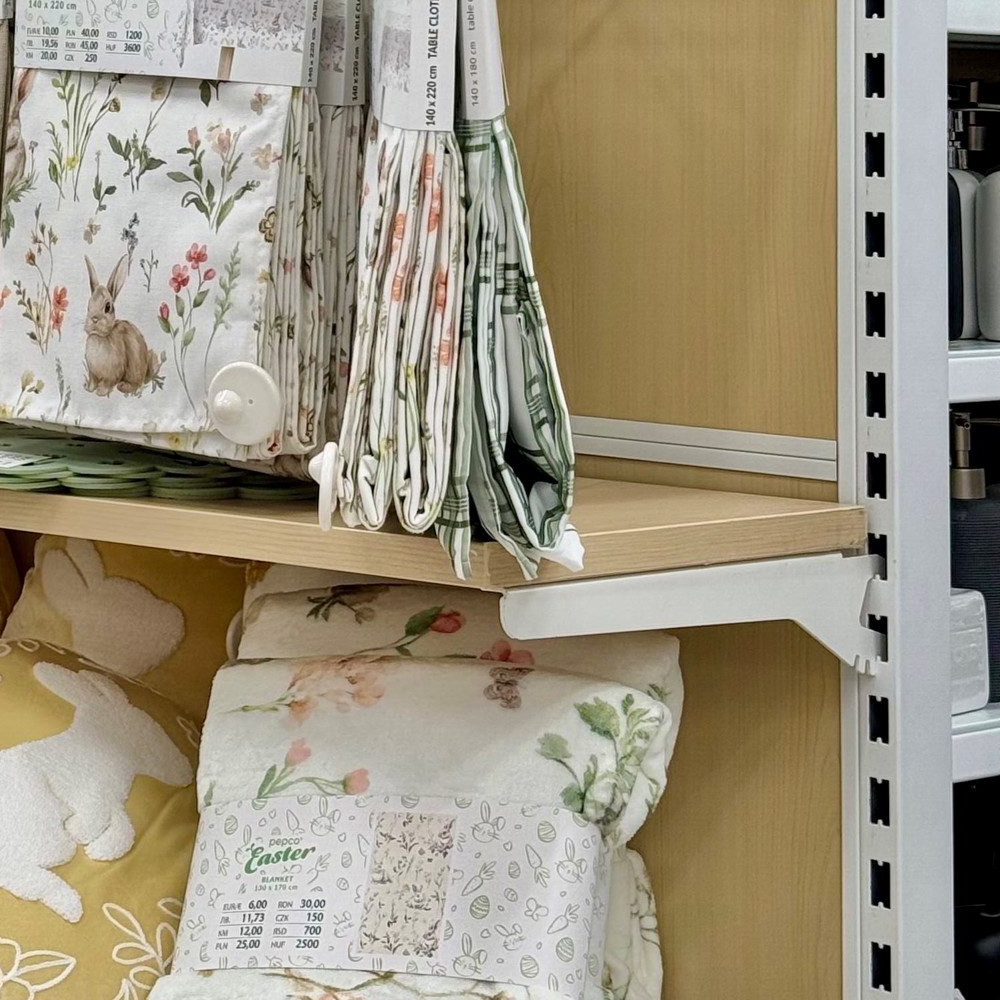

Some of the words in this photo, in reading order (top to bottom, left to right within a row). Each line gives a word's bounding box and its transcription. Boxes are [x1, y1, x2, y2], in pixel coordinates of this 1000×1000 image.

[28, 0, 42, 9] 140
[50, 0, 65, 10] 220
[466, 4, 476, 31] table
[42, 26, 59, 36] 10,00
[81, 28, 99, 38] 40,00
[125, 30, 142, 40] 1200
[41, 39, 58, 48] 19,56
[80, 41, 98, 50] 45,00
[123, 43, 141, 52] 3600
[427, 28, 439, 59] TABLE
[470, 41, 477, 55] cm
[40, 51, 57, 60] 20,00
[85, 53, 97, 62] 250
[469, 57, 478, 76] 180
[429, 65, 438, 79] cm
[426, 81, 437, 99] 220
[470, 88, 479, 106] 140
[426, 108, 436, 127] 140
[269, 838, 300, 847] pepco
[245, 843, 316, 874] Easter
[248, 900, 267, 910] 6,00
[278, 901, 293, 909] RON
[300, 899, 326, 909] 30,00
[242, 913, 265, 923] 11,73
[307, 912, 324, 922] 150
[239, 926, 263, 937] 12,00
[304, 926, 321, 935] 700
[215, 942, 228, 950] PLN
[235, 939, 261, 950] 25,00
[295, 939, 319, 949] 2500
